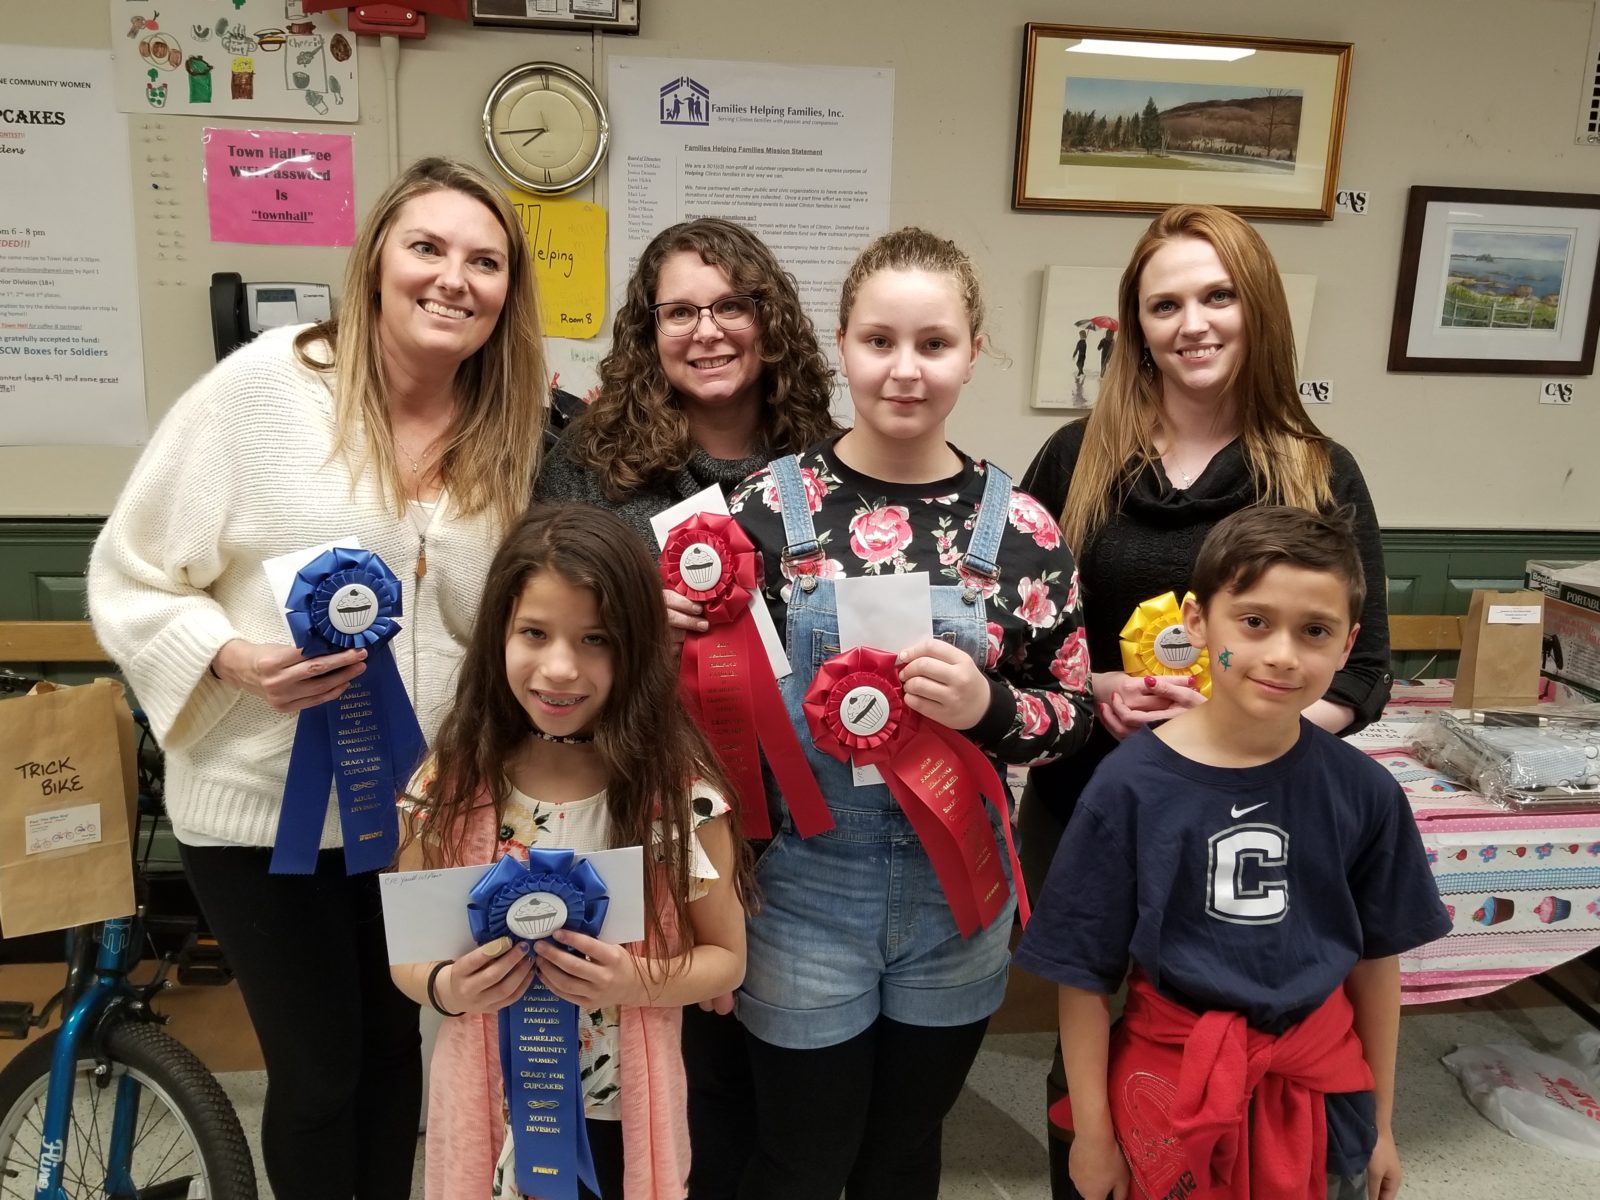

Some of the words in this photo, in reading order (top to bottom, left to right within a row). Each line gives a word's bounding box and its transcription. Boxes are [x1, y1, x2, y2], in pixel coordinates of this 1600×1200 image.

[9, 79, 58, 87] COMMUNITY
[711, 104, 747, 114] Families
[750, 105, 785, 117] Helping
[787, 106, 825, 118] Families,
[828, 108, 844, 118] Inc.
[0, 109, 66, 126] CAKES
[228, 146, 264, 158] Town
[270, 148, 296, 159] Hall
[684, 144, 711, 152] Families
[712, 145, 736, 153] Helping
[792, 148, 822, 156] Statement
[276, 190, 288, 200] Is
[1336, 192, 1366, 213] CAS
[26, 228, 30, 236] 8
[560, 314, 584, 324] Room
[586, 312, 592, 324] 8
[39, 336, 70, 344] accepted
[24, 347, 51, 355] Boxes
[54, 347, 67, 355] for
[70, 348, 108, 356] Soldiers
[1299, 382, 1329, 401] CAS
[1545, 383, 1572, 402] CAS
[346, 746, 374, 754] WOMEN
[14, 756, 76, 779] TRICK
[344, 765, 380, 775] CUPCAKES
[42, 775, 84, 796] BIKE
[1205, 822, 1290, 925] C
[529, 1115, 557, 1123] YOUTH
[526, 1125, 560, 1134] DIVISION
